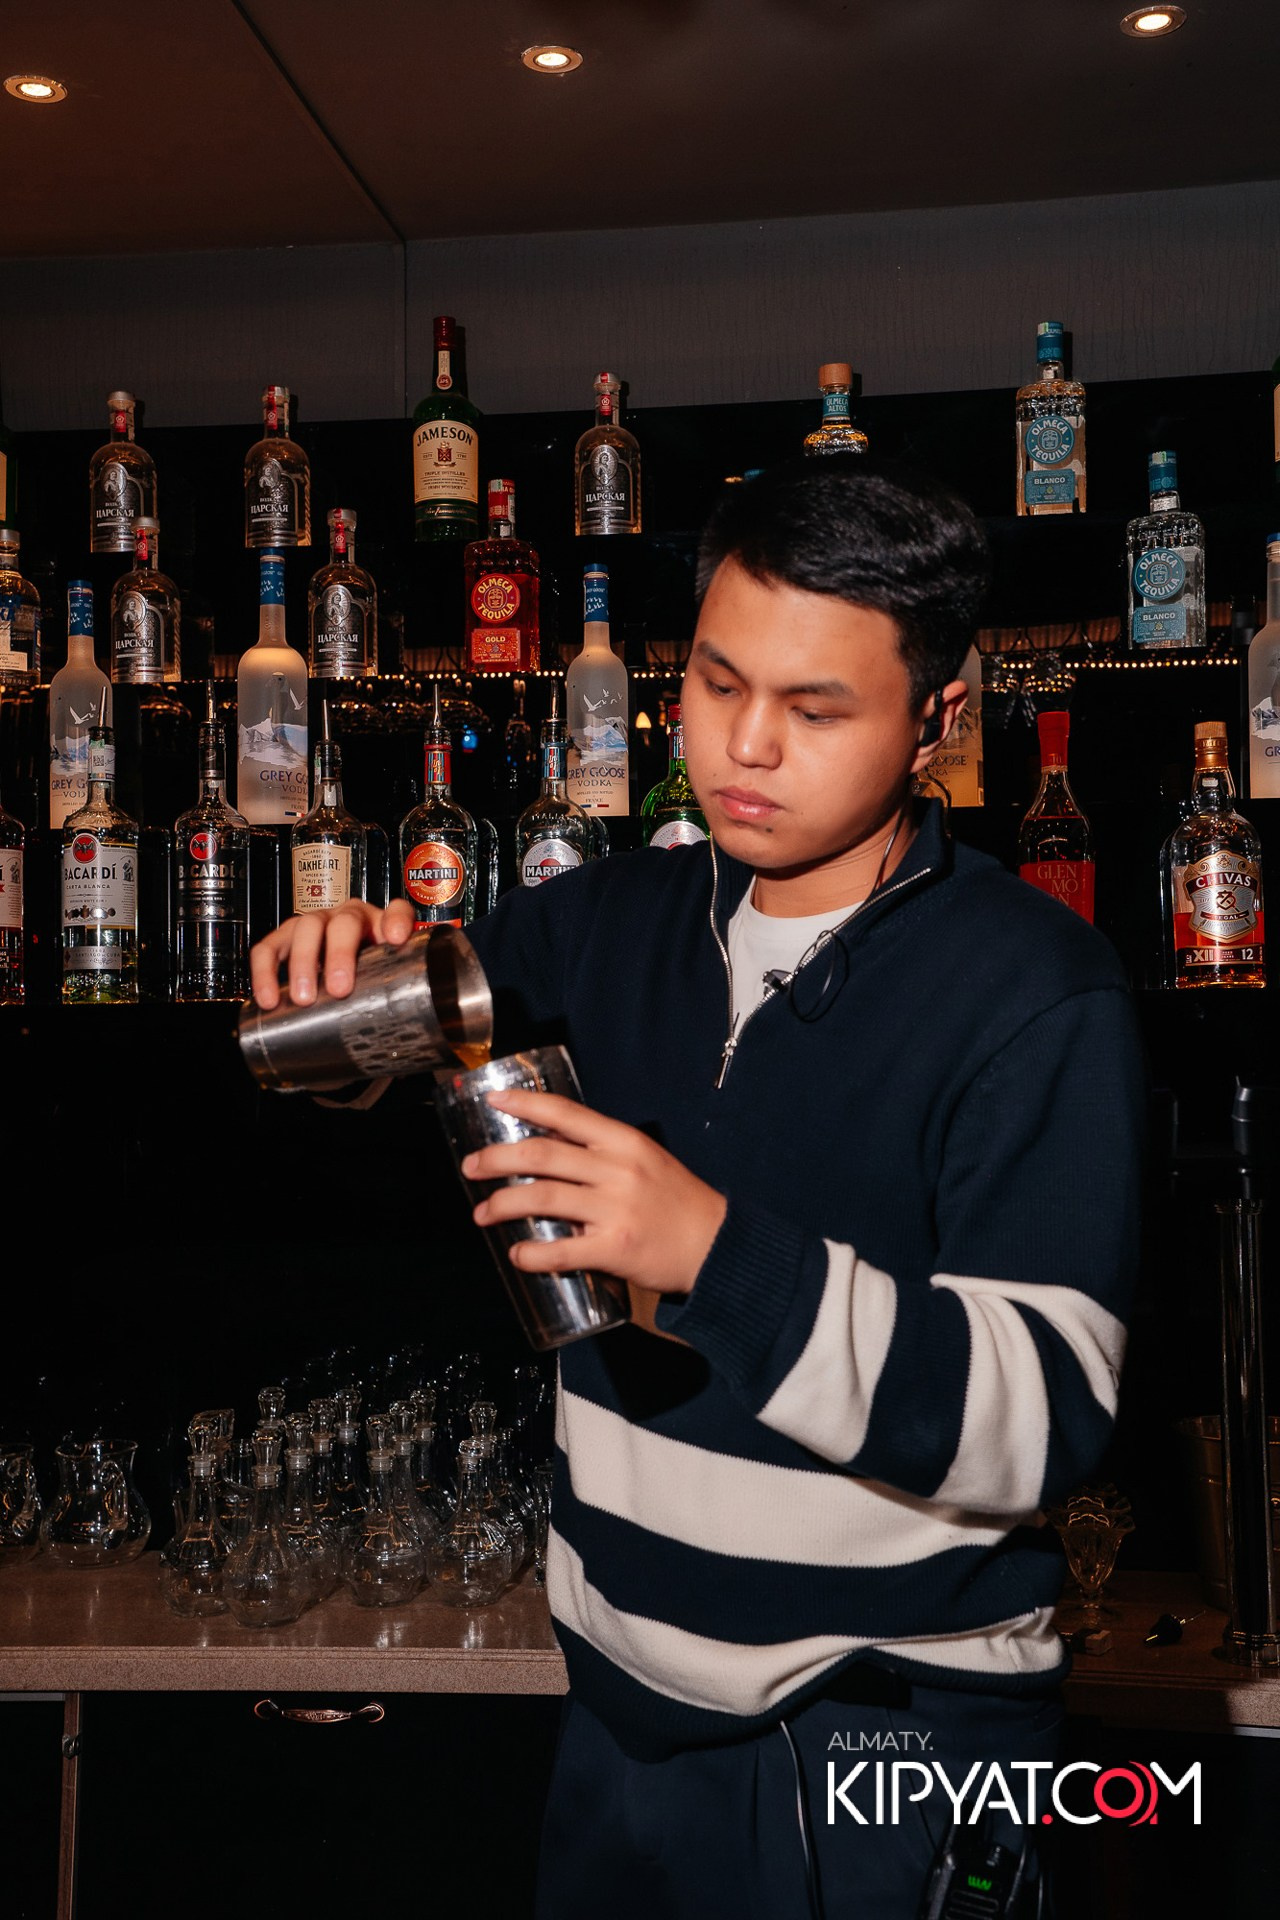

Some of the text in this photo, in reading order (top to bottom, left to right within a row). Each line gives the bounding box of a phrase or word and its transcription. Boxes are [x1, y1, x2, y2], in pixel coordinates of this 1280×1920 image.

[826, 398, 848, 406] OLMECA
[1031, 419, 1069, 436] OLMECA
[417, 426, 473, 447] JAMESON
[1031, 443, 1070, 461] TEQUILA
[1034, 477, 1066, 485] BLANCO
[585, 492, 625, 503] ЦАРСКАЯ
[96, 509, 135, 518] ЦАРСКАЯ
[250, 504, 289, 514] ЦАРСКАЯ
[1139, 552, 1178, 570] OLMECA
[477, 578, 513, 594] OLMECA
[1140, 577, 1180, 596] TEQUILA
[477, 602, 515, 619] TEQUILA
[1142, 612, 1176, 621] BLANCO
[115, 639, 154, 650] ЦАРСКАЯ
[317, 633, 359, 644] ЦАРСКАЯ
[260, 770, 292, 782] GREY
[589, 767, 626, 779] GOOSE
[52, 779, 73, 791] GREY
[64, 863, 116, 880] BACARDÍ
[179, 861, 236, 878] BCARDÍ
[409, 868, 457, 880] MARTINI
[526, 866, 576, 877] MARTI
[1038, 864, 1077, 879] GLEN
[1051, 880, 1079, 893] MO
[1195, 873, 1252, 888] CHIVAS
[1193, 949, 1214, 962] XII
[1241, 948, 1254, 960] 12
